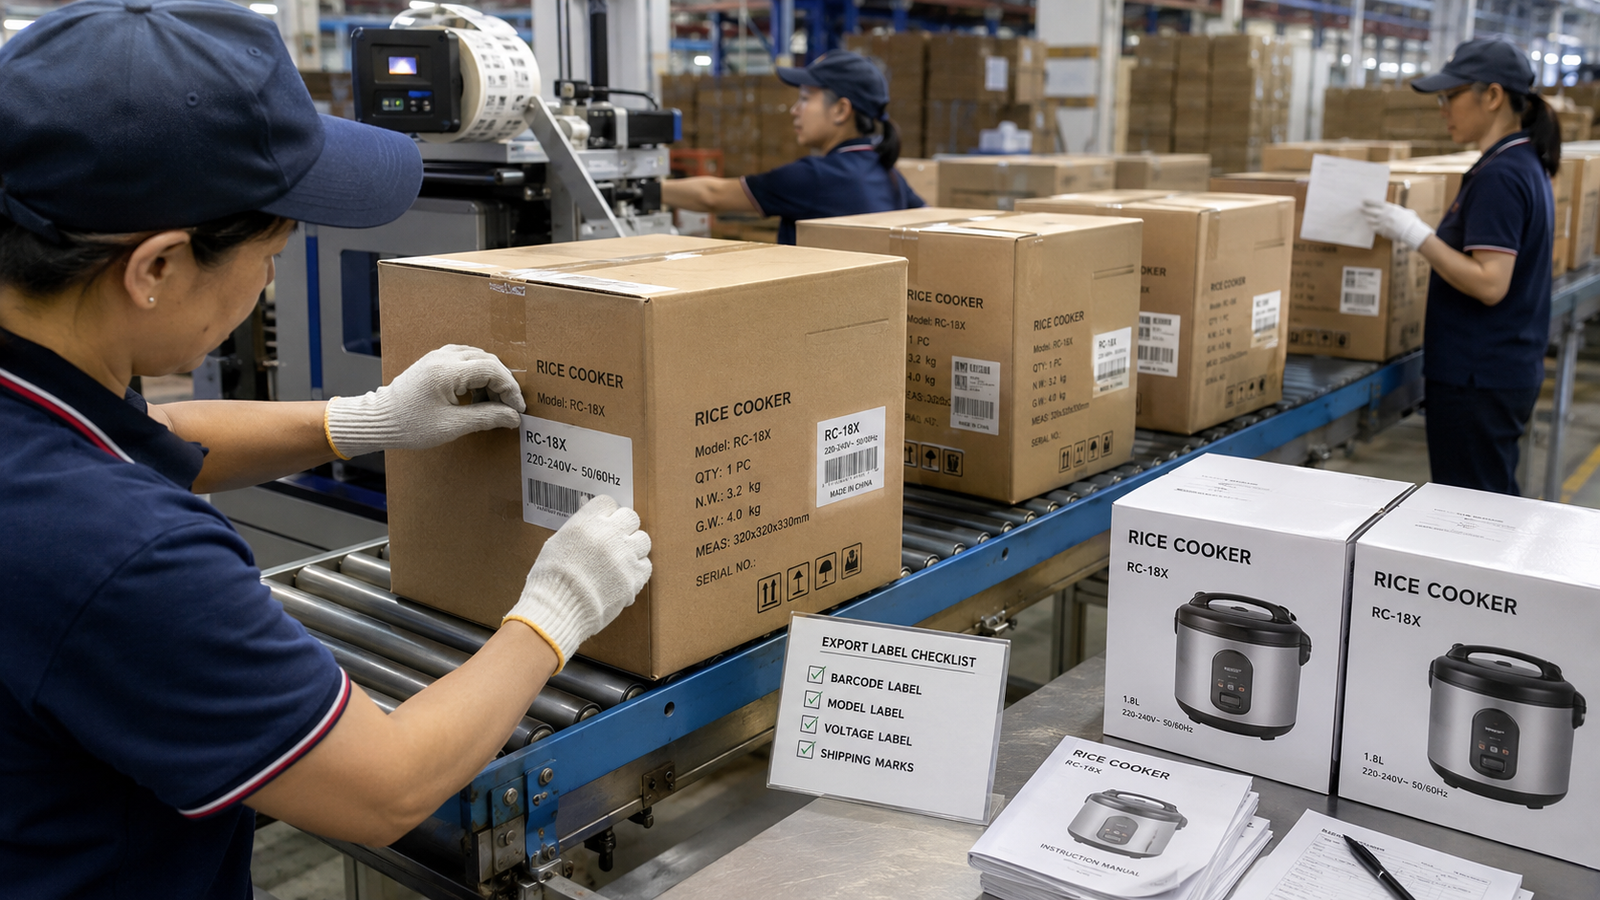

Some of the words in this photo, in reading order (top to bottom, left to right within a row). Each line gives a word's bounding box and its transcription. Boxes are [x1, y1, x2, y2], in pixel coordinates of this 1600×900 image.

[907, 289, 932, 303] RICE
[935, 292, 984, 309] COOKER
[1033, 317, 1052, 331] RICE
[1054, 310, 1084, 327] COOKER
[917, 336, 930, 346] PC
[908, 353, 921, 364] 3.2
[925, 355, 936, 368] kg
[536, 360, 565, 378] RICE
[568, 366, 624, 390] COOKER
[925, 374, 936, 386] kg
[537, 392, 568, 408] Model:
[570, 399, 606, 417] RC-18X
[695, 406, 729, 426] RICE
[733, 391, 791, 416] COOKER
[526, 430, 568, 452] RC-18X
[695, 440, 730, 458] Model:
[733, 428, 772, 448] RC-18X
[824, 422, 860, 441] RC-18X
[526, 452, 578, 472] 220-240V~
[581, 466, 621, 486] 50/60Hz
[695, 466, 722, 484] QTY:
[727, 464, 732, 474] 1
[736, 458, 751, 473] PC
[695, 491, 724, 509] N.W.:
[726, 485, 742, 499] 3.2
[748, 481, 761, 493] kg
[830, 486, 847, 498] MADE
[848, 484, 854, 492] IN
[854, 480, 872, 490] CHINA
[695, 515, 724, 533] G.W.:
[726, 508, 742, 522] 4.0
[748, 504, 761, 517] kg
[695, 538, 730, 558] MEAS:
[733, 513, 810, 546] 320x320x330mm
[1128, 529, 1168, 550] RICE
[1173, 537, 1252, 565] COOKER
[695, 566, 733, 587] SERIAL
[736, 558, 756, 573] NO.:
[1127, 561, 1169, 579] RC-18X
[1374, 570, 1420, 594] RICE
[1427, 582, 1518, 616] COOKER
[1372, 606, 1422, 628] RC-18X
[822, 636, 868, 653] EXPORT
[871, 643, 908, 658] LABEL
[911, 648, 976, 668] CHECKLIST
[830, 672, 884, 690] BARCODE
[888, 681, 922, 696] LABEL
[827, 698, 866, 714] MODEL
[870, 704, 904, 719] LABEL
[1123, 694, 1140, 706] 1.8L
[1122, 708, 1160, 724] 220-240V~
[1163, 718, 1194, 734] 50/60Hz
[824, 723, 874, 740] VOLTAGE
[878, 732, 912, 747] LABEL
[820, 748, 871, 766] SHIPPING
[874, 757, 914, 773] MARKS
[1064, 759, 1103, 775] RC-18X
[1072, 749, 1107, 764] RICE
[1108, 758, 1170, 781] COOKER
[1363, 752, 1384, 766] 1.8L
[1362, 766, 1409, 786] 220-240V~
[1412, 780, 1448, 798] 50/60Hz
[1040, 842, 1100, 866] INSTRUCTION
[1101, 862, 1140, 878] MANUAL
